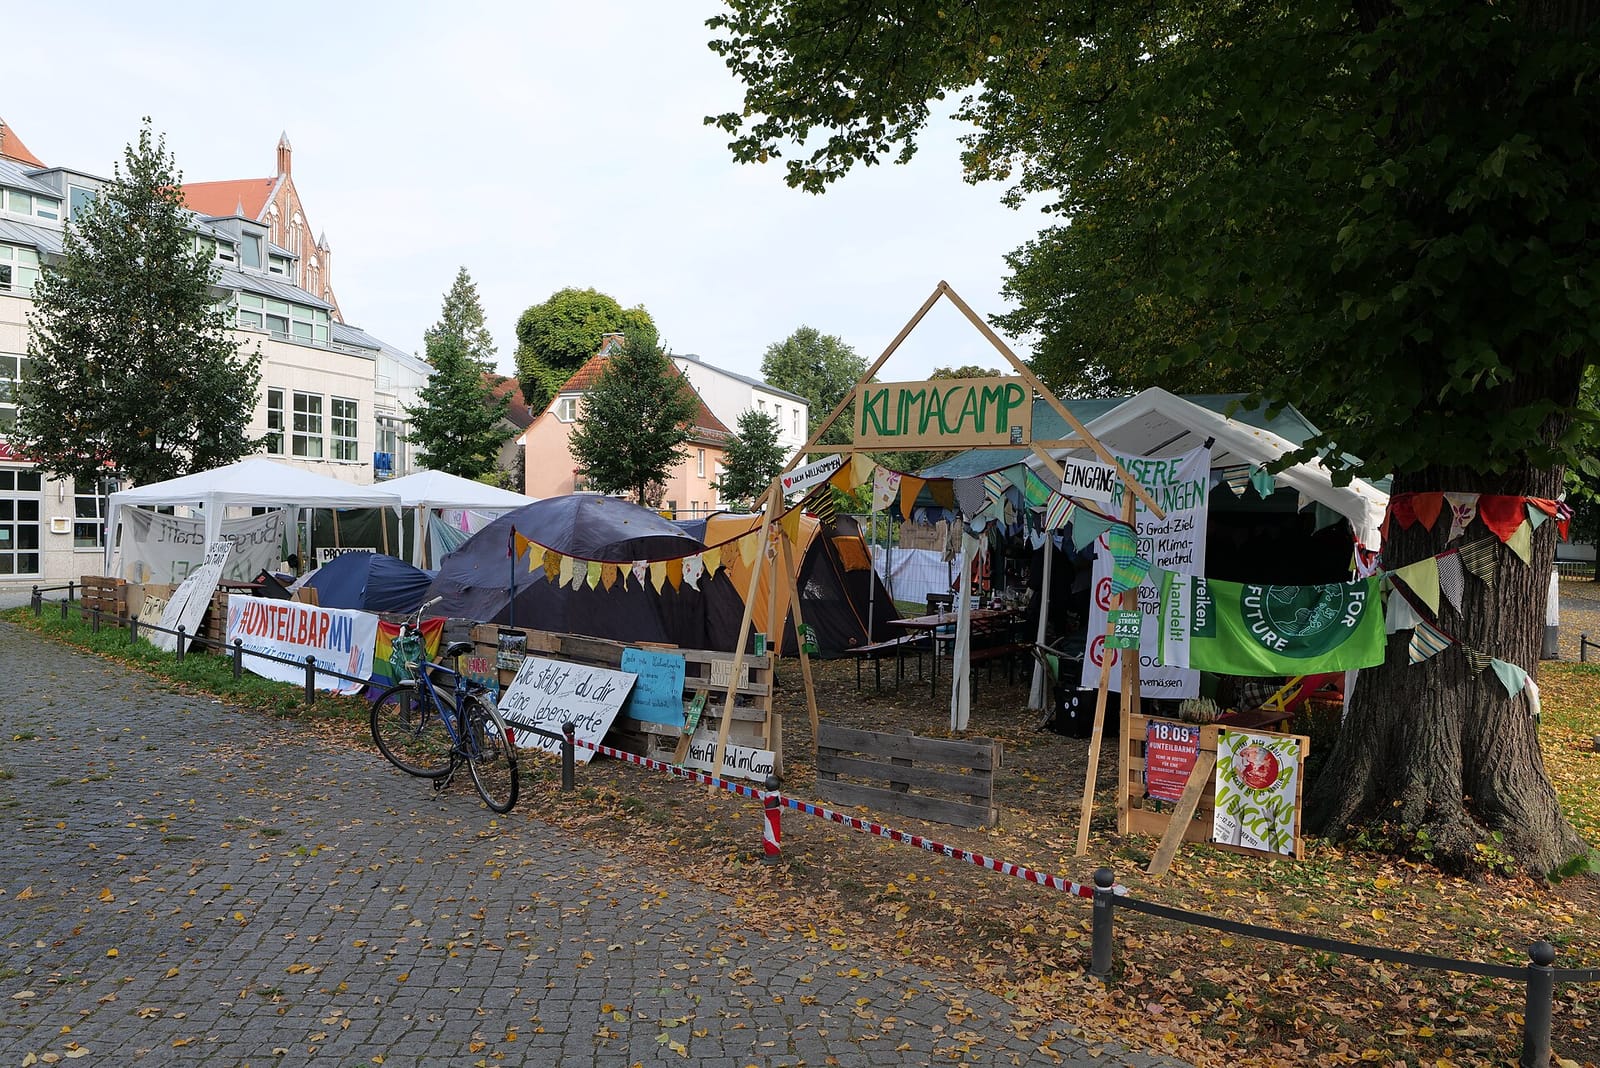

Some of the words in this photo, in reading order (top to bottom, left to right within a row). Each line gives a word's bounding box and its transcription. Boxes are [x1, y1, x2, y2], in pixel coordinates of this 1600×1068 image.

[861, 383, 1026, 437] KLIMACAMP
[804, 457, 841, 480] WILLKOMMEN
[1063, 463, 1115, 493] EINGANG
[1146, 515, 1194, 536] Grad-Ziel
[1157, 538, 1194, 553] Klima-
[1157, 549, 1193, 568] neutral
[1170, 581, 1187, 642] handelt!
[1244, 585, 1289, 652] FUTURE
[1341, 591, 1365, 628] FOR
[238, 601, 353, 653] #UNTEILBARMV
[1115, 624, 1140, 634] 24.9.
[533, 662, 572, 697] stellst
[574, 673, 594, 698] du
[591, 676, 617, 703] dir
[508, 691, 532, 712] eine
[1154, 724, 1194, 744] 18.09.
[689, 744, 705, 760] Kein
[704, 743, 737, 768] Alhol
[738, 749, 750, 769] im
[750, 750, 774, 778] Camp
